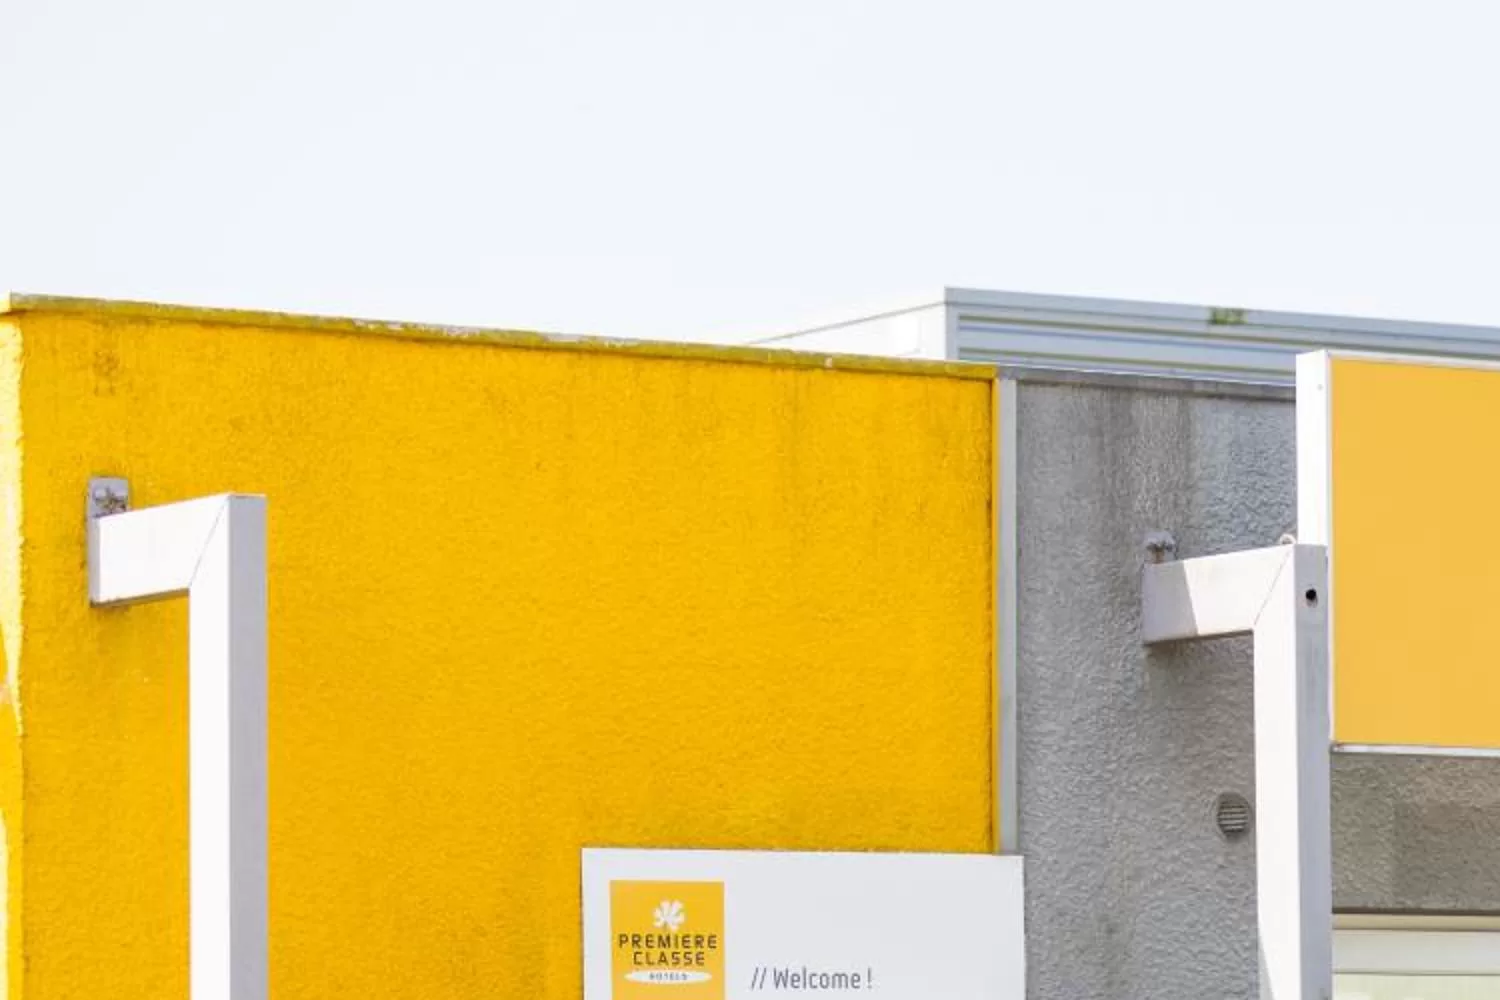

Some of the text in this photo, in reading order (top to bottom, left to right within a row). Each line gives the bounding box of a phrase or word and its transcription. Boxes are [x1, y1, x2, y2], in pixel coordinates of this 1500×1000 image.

[618, 933, 718, 950] PREMIERE
[632, 951, 706, 966] CLASSE
[773, 965, 861, 990] Welcome
